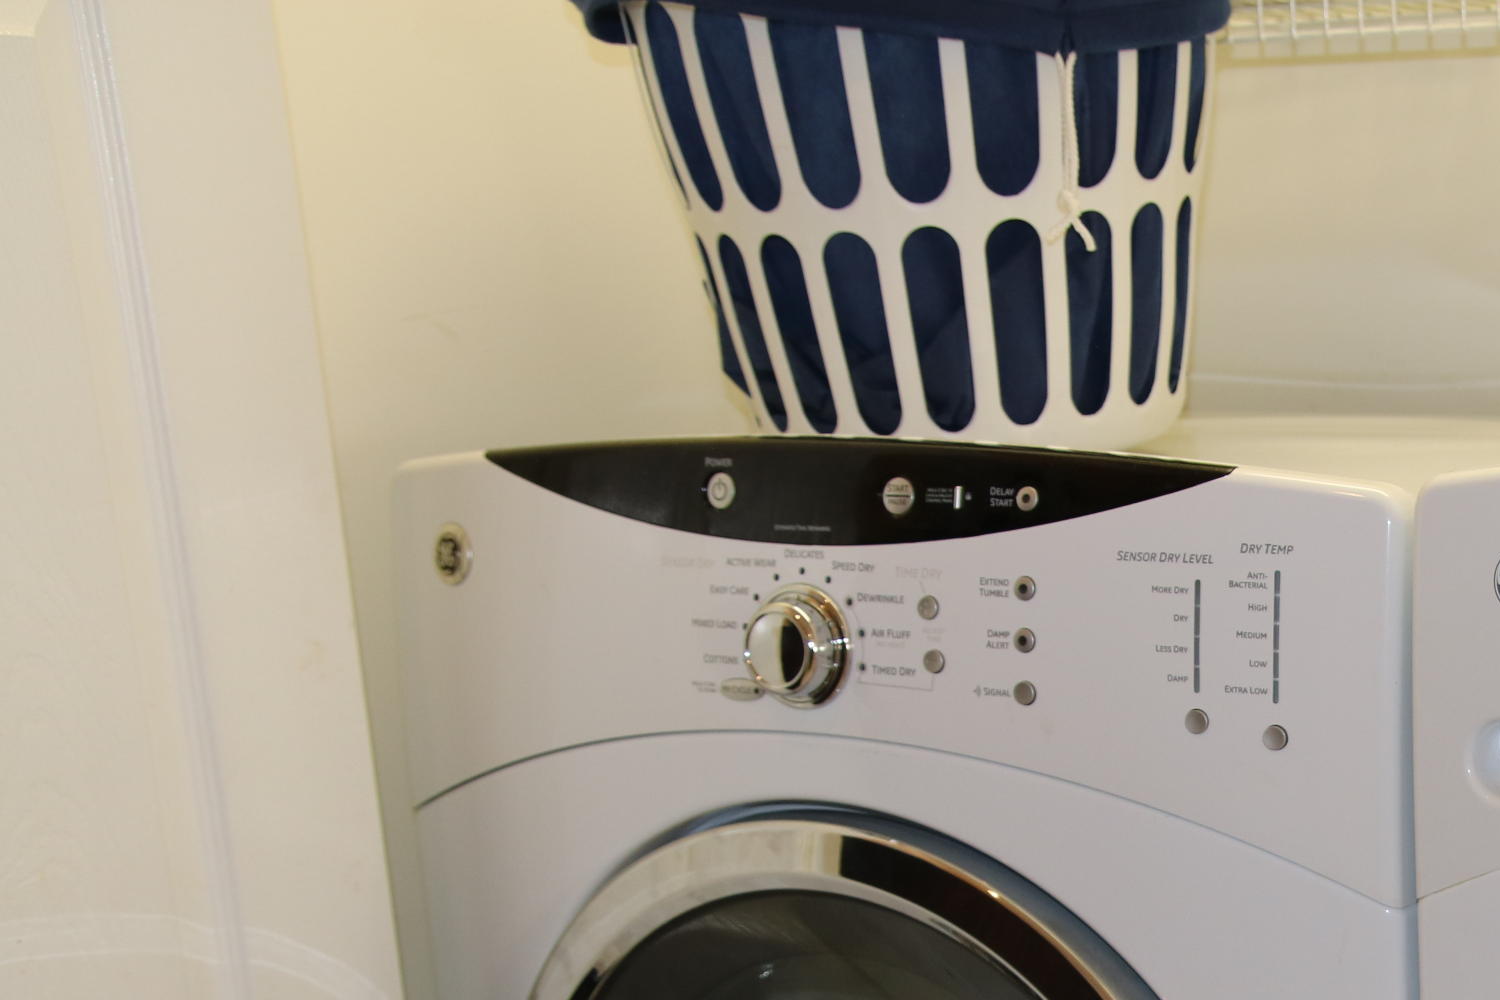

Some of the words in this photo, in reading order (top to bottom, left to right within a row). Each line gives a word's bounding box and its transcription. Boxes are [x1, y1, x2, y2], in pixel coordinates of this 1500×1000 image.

[990, 487, 1014, 496] DELAY
[990, 498, 1014, 507] START
[1240, 543, 1262, 555] DRY
[1264, 543, 1295, 555] TEMP
[1116, 550, 1157, 563] SENSOR
[1158, 552, 1181, 563] DRY
[1182, 553, 1214, 565] LEVEL
[858, 562, 875, 573] DRY
[1247, 571, 1268, 580] ANTI-
[979, 577, 1009, 587] EXTEND
[1228, 580, 1268, 590] BACTERIAL
[979, 588, 1009, 598] TUMBLE
[1151, 586, 1172, 594] MORE
[1174, 586, 1189, 594] DRY
[1248, 603, 1268, 612] HIGH
[1173, 614, 1189, 622] DRY
[887, 629, 911, 639] FLUFF
[987, 629, 1010, 638] DAMP
[1236, 631, 1267, 639] MEDIUM
[986, 640, 1010, 649] ALERT
[1155, 645, 1172, 653] LESS
[1173, 645, 1188, 653] DRY
[1249, 659, 1267, 668] LOW
[872, 665, 897, 676] TIMED
[899, 666, 916, 677] DRY
[1167, 674, 1189, 683] DAMP
[983, 687, 1011, 698] SIGNAL
[1225, 685, 1248, 694] EXTRA
[1250, 686, 1268, 695] LOW
